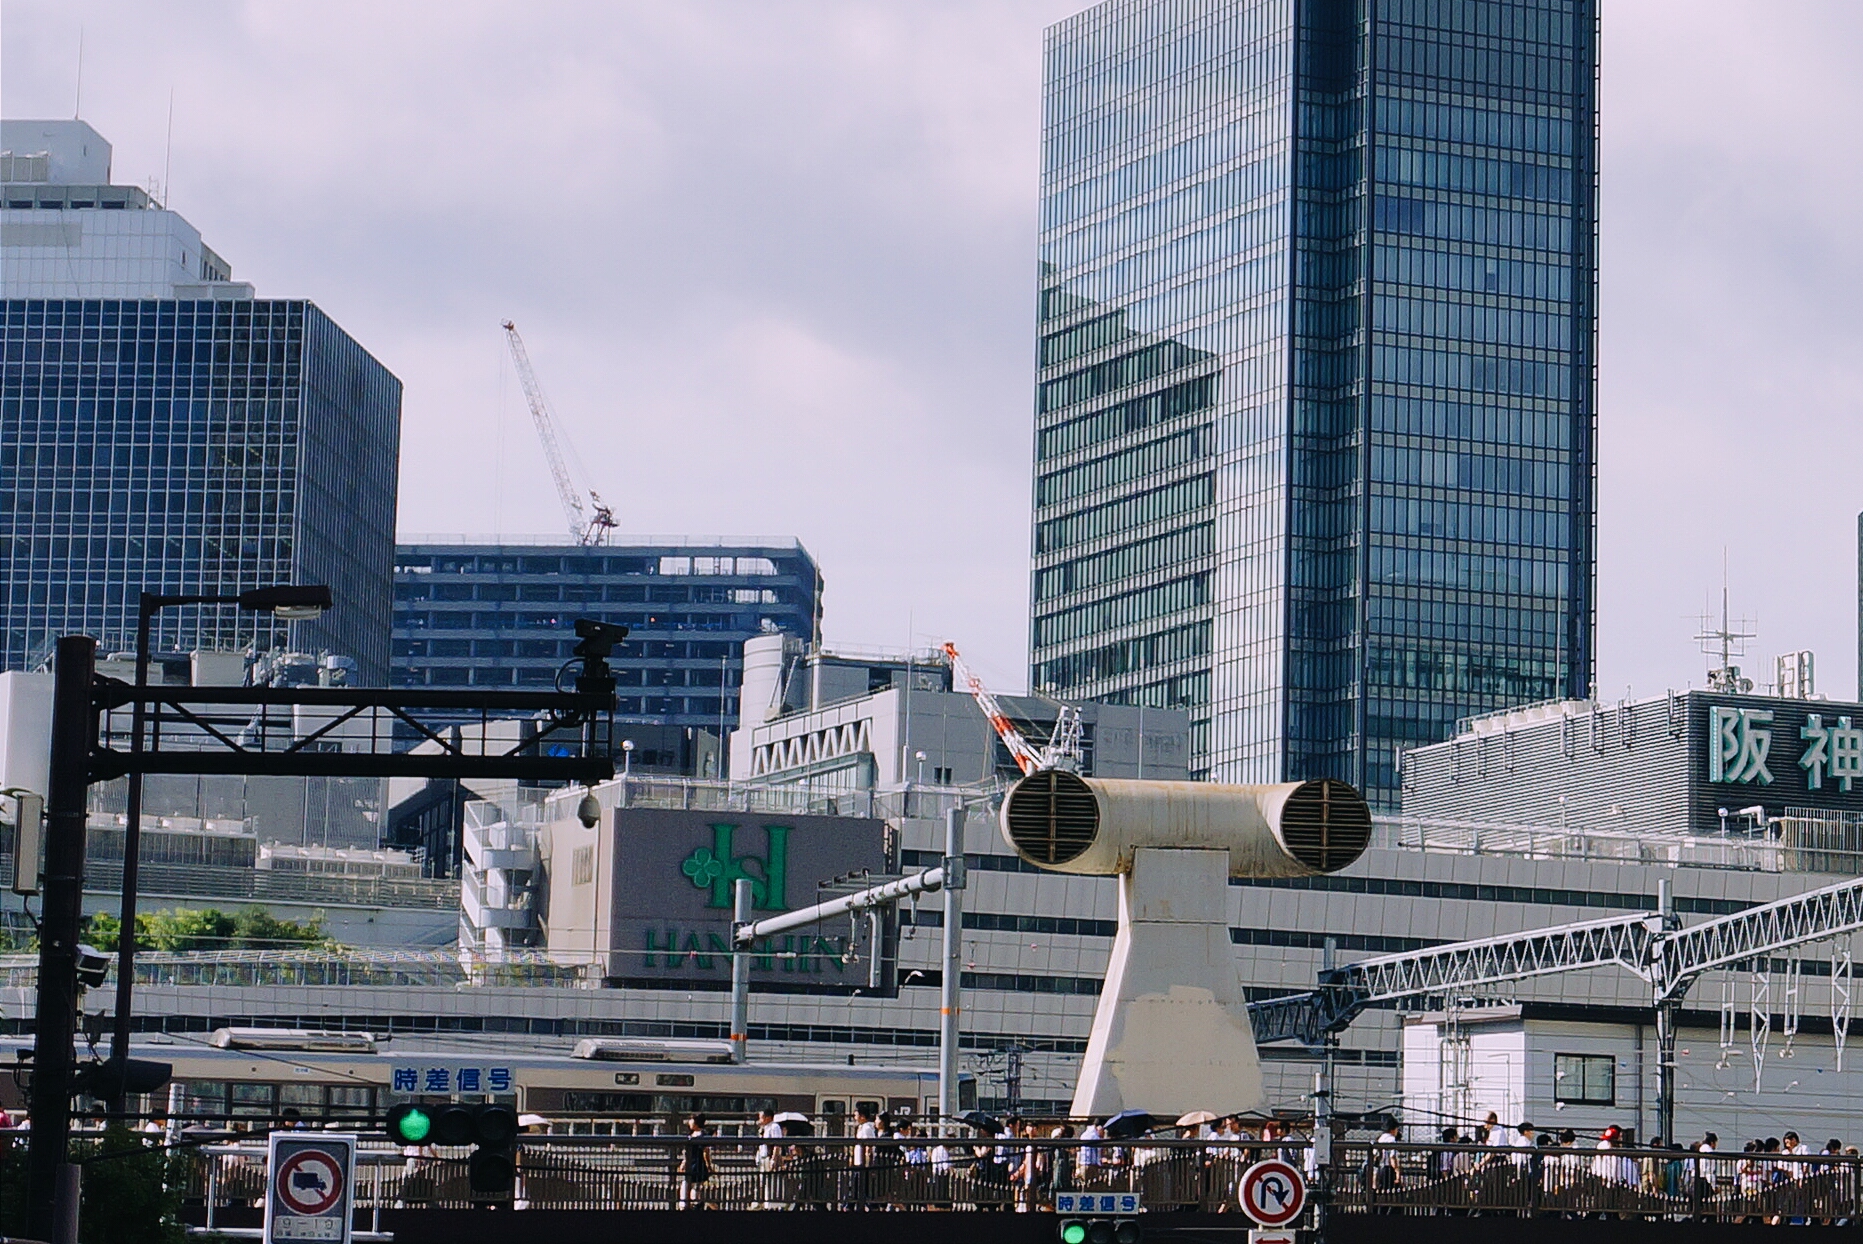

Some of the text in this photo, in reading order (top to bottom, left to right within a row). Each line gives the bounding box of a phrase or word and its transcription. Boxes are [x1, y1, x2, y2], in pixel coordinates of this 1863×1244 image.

[1709, 706, 1863, 793] 阪神
[644, 930, 845, 973] HANHIN
[394, 1067, 512, 1091] 時差信号
[1058, 1195, 1136, 1212] 時差信号
